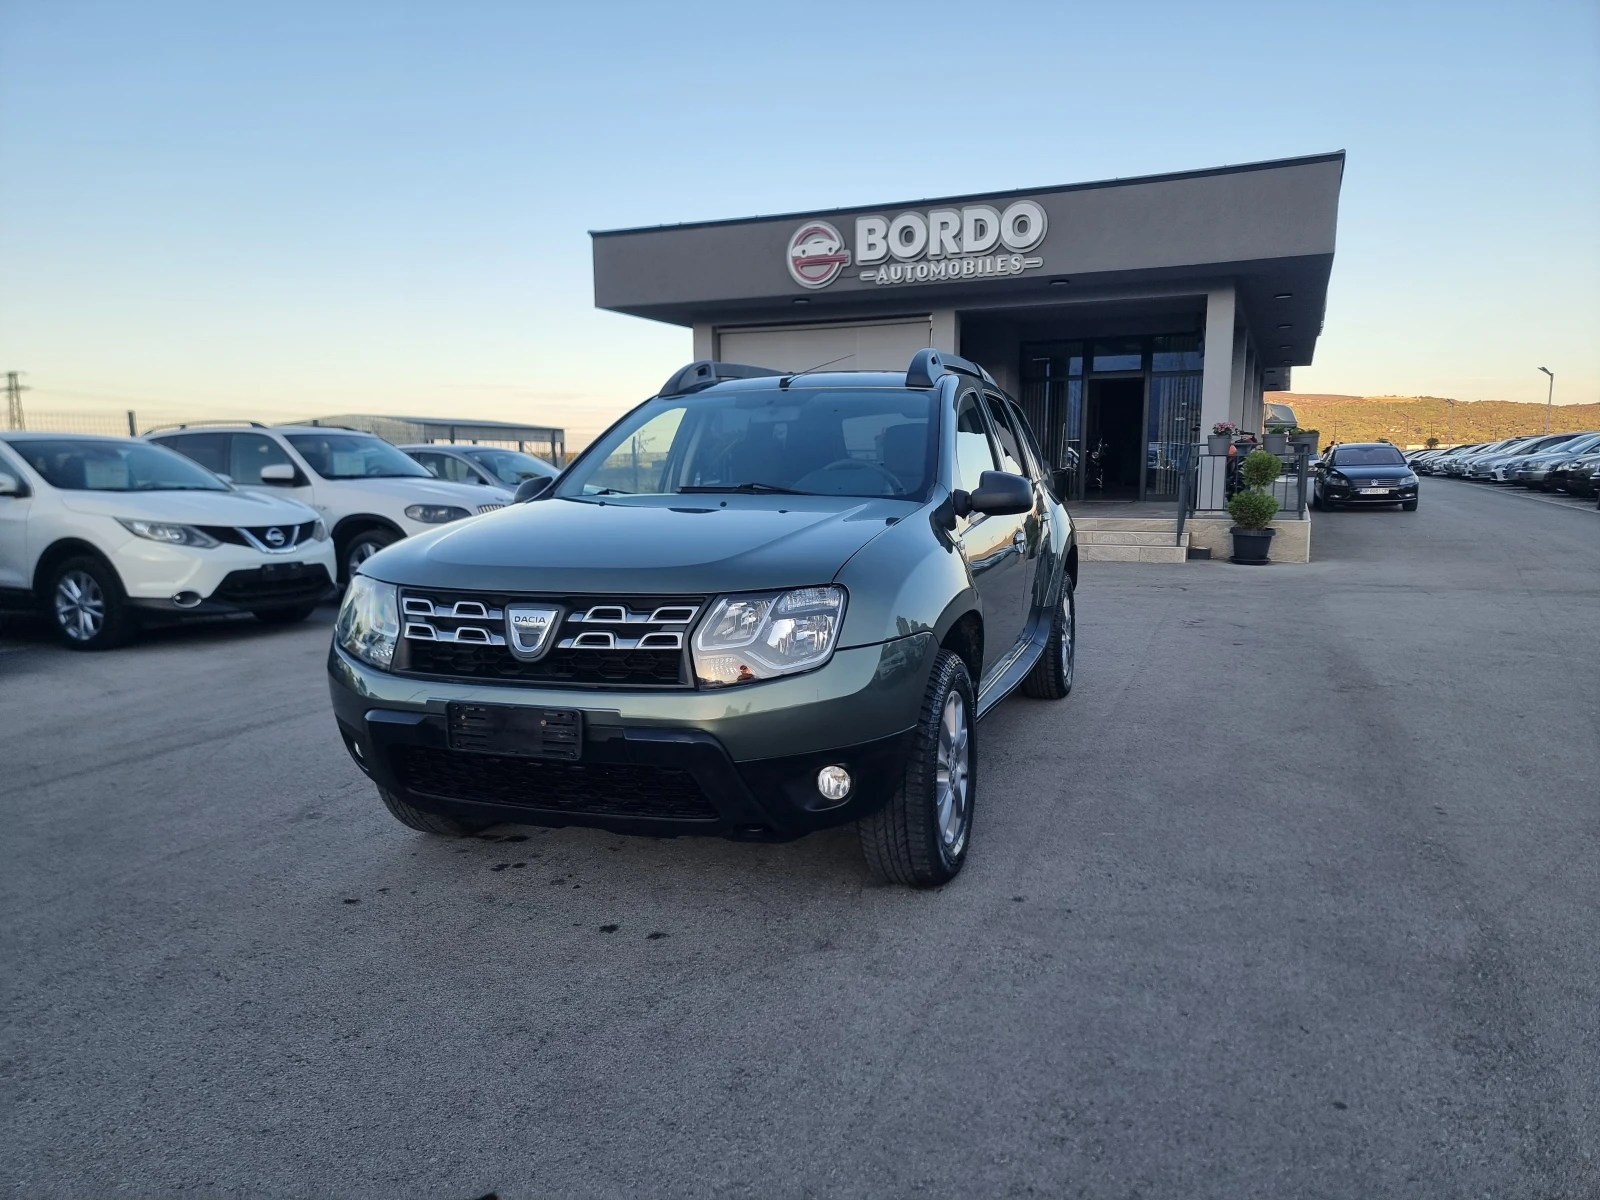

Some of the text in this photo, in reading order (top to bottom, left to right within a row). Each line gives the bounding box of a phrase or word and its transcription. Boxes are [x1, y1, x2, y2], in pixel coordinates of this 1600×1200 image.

[856, 202, 1045, 262] BORDO
[876, 256, 1022, 282] AUTOMOBILES
[514, 615, 546, 624] DACIA
